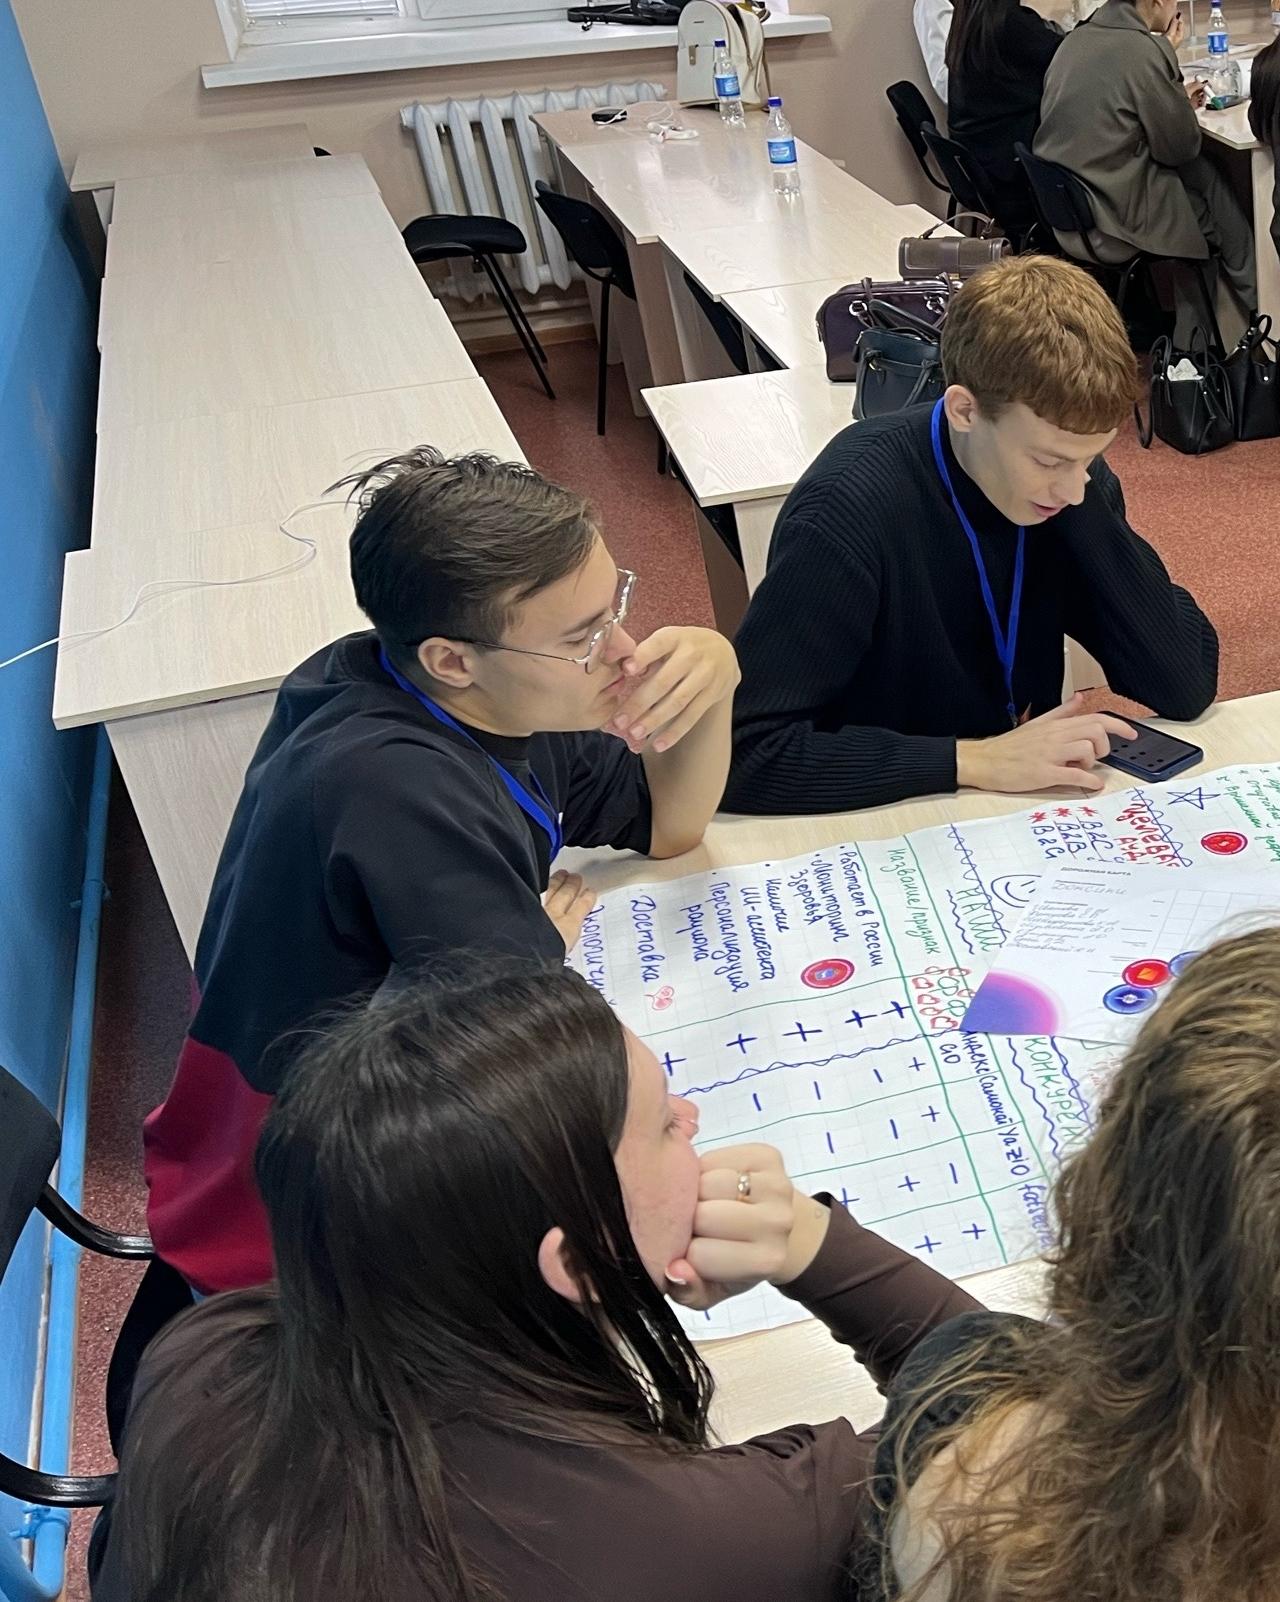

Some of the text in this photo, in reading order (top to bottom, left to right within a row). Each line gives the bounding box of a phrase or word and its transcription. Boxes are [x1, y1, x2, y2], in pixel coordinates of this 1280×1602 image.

[676, 904, 709, 961] рациона
[740, 887, 775, 980] ИИ-ассистента
[766, 878, 790, 932] Наличие
[810, 858, 850, 943] Мониторинг
[630, 895, 665, 983] Доставка
[705, 882, 749, 992] Персонализация
[861, 922, 885, 967] России
[979, 1075, 1016, 1126] Самокат
